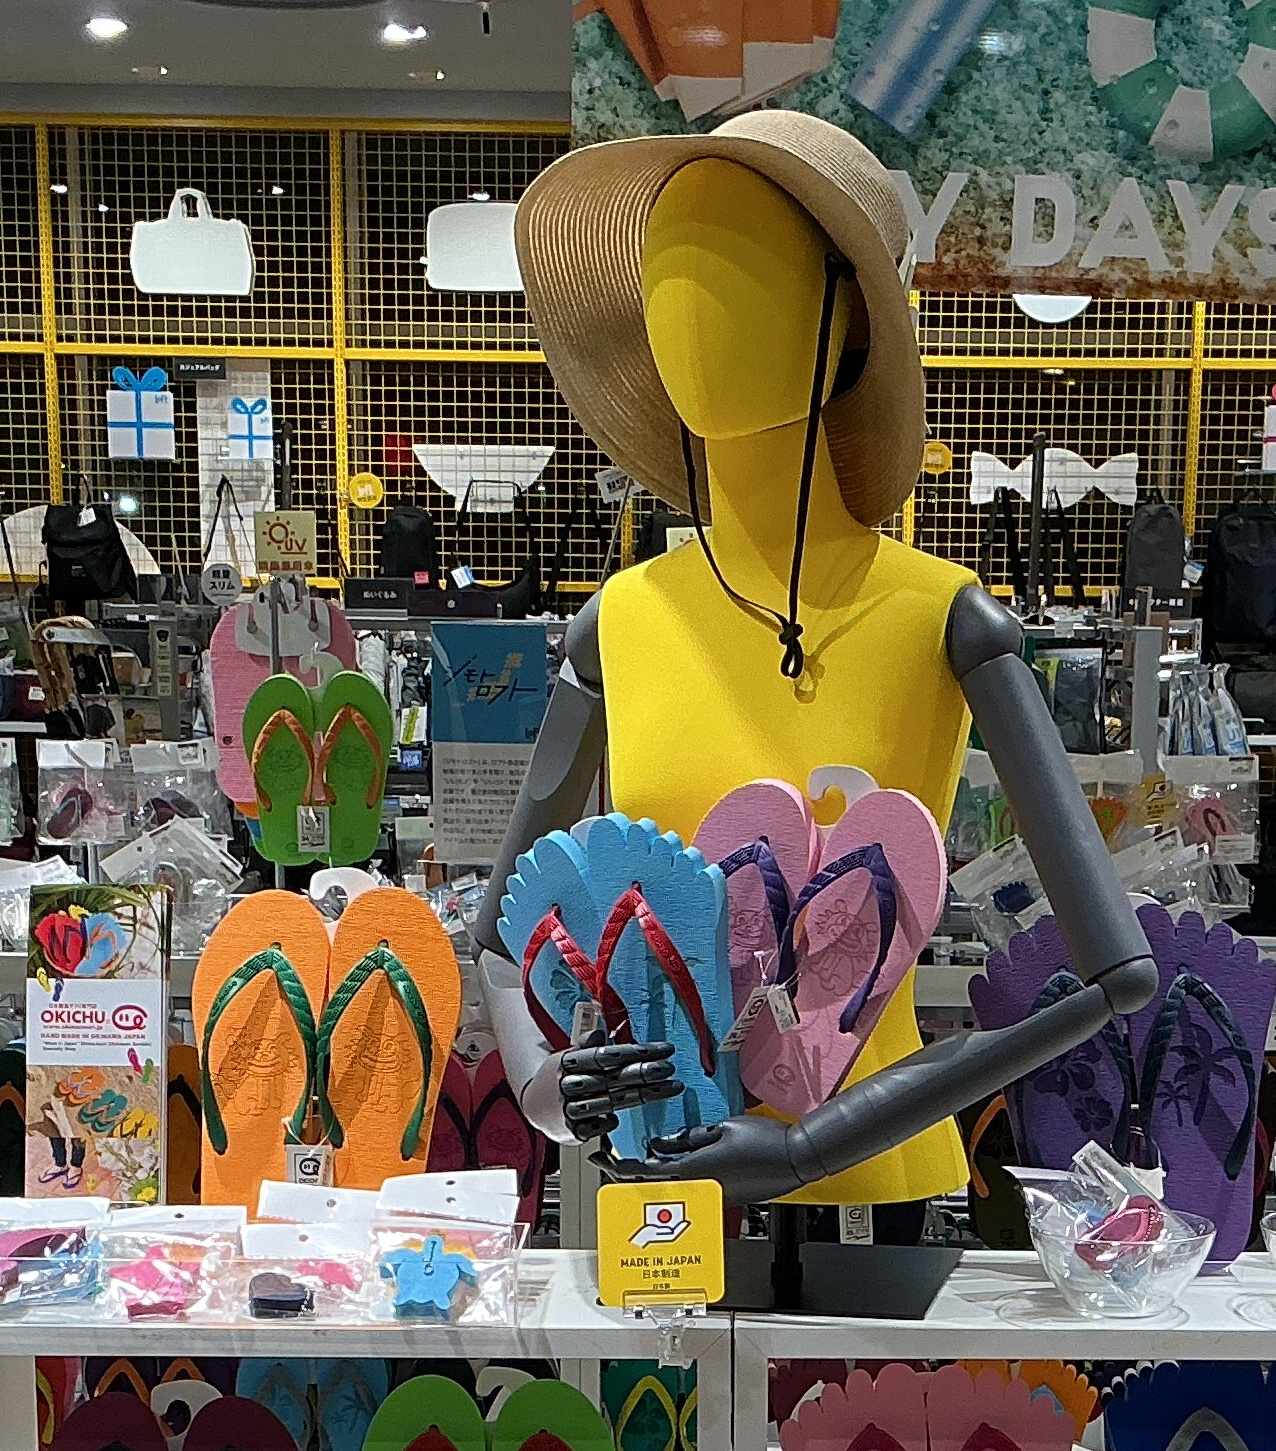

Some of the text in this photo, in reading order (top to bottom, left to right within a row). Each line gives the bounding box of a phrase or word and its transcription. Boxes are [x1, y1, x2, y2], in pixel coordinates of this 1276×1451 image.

[285, 538, 308, 552] UV
[475, 677, 539, 706] ロフト
[40, 1009, 106, 1024] OKICHU
[620, 1254, 702, 1268] MADE IN JAPAN
